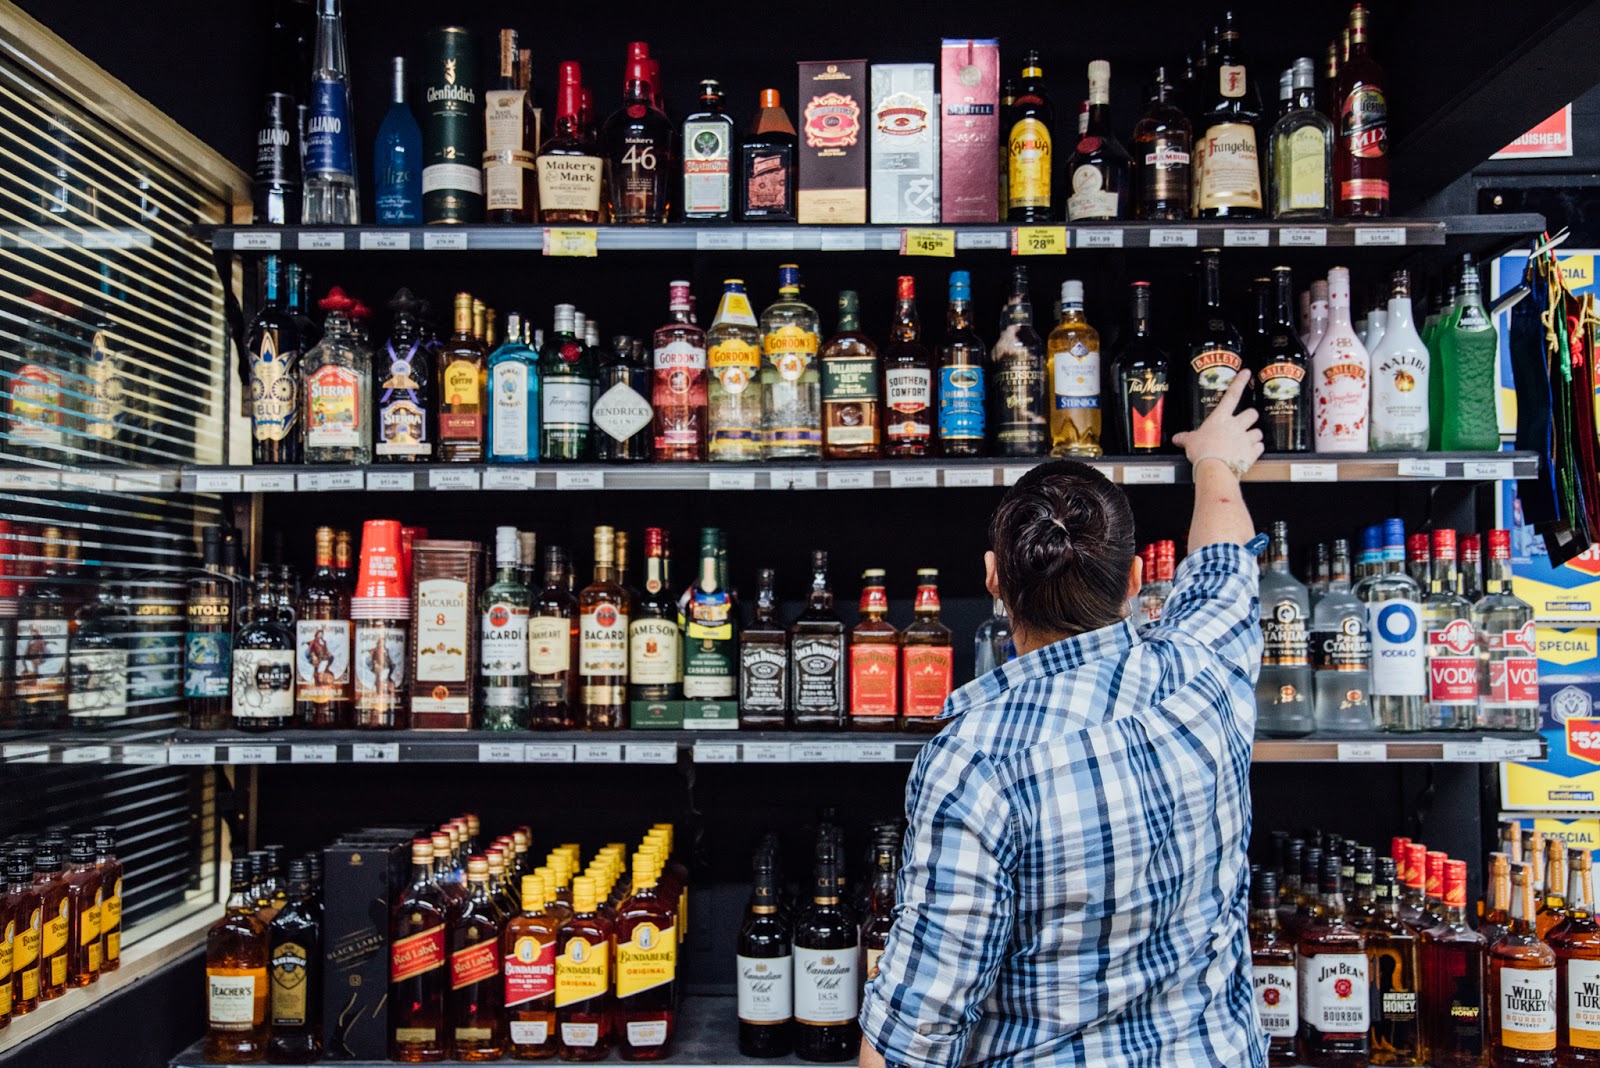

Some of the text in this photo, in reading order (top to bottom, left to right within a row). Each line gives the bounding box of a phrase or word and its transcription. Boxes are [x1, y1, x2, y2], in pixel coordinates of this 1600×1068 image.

[427, 85, 476, 104] Glenfiddich
[1350, 127, 1388, 152] MIX
[443, 146, 456, 160] 12
[621, 144, 657, 172] 46
[546, 161, 596, 171] Maker's
[560, 172, 595, 183] Mark
[1294, 192, 1322, 206] vok
[1561, 268, 1587, 279] CIAL
[770, 337, 811, 350] GORDON'S
[659, 352, 701, 365] GORDON'S
[714, 350, 755, 363] GORDON'S
[1194, 353, 1241, 370] BAILEYS
[827, 362, 873, 374] TULLAMORE
[1260, 363, 1303, 379] BAILEYS
[888, 376, 928, 388] SOUTHERN
[1127, 378, 1144, 394] Tia
[311, 383, 353, 398] SIERRA
[891, 387, 926, 398] COMFORT
[1060, 397, 1099, 409] STEINBOK
[256, 404, 282, 417] BLU
[595, 407, 651, 418] HENDRICK'S
[383, 413, 423, 426] SIERRA
[188, 605, 230, 616] NTOLD
[435, 612, 446, 626] 8
[632, 624, 678, 639] JAMESON
[1538, 641, 1591, 652] SPECIAL
[258, 671, 289, 680] KRAKEN
[687, 666, 729, 675] CASKMATES
[1432, 667, 1477, 685] VODK
[393, 950, 411, 965] Red
[454, 952, 495, 974] Red Label
[619, 951, 674, 965] BUNDABERG
[505, 962, 555, 976] BUNDABERG
[556, 963, 605, 977] BUNDABERG
[625, 968, 666, 976] ORIGINAL
[741, 967, 783, 981] Canadian
[804, 960, 851, 975] Canadian
[1318, 965, 1338, 984] JIM
[750, 981, 773, 995] Club
[814, 975, 840, 991] Club
[1582, 983, 1600, 997] WI
[210, 983, 253, 998] TEACHER'S
[817, 992, 839, 1002] 1858
[1383, 992, 1416, 1000] AMERICAN
[1511, 985, 1542, 1000] WILD
[752, 994, 771, 1003] 1858
[1504, 993, 1549, 1012] TURKEY
[1574, 991, 1600, 1009] TUR
[1383, 1000, 1417, 1013] HONEY
[1450, 1009, 1480, 1017] HONEY
[1323, 1010, 1363, 1022] BOURBON
[1505, 1014, 1548, 1023] BOURBON
[1575, 1012, 1600, 1021] BOUR
